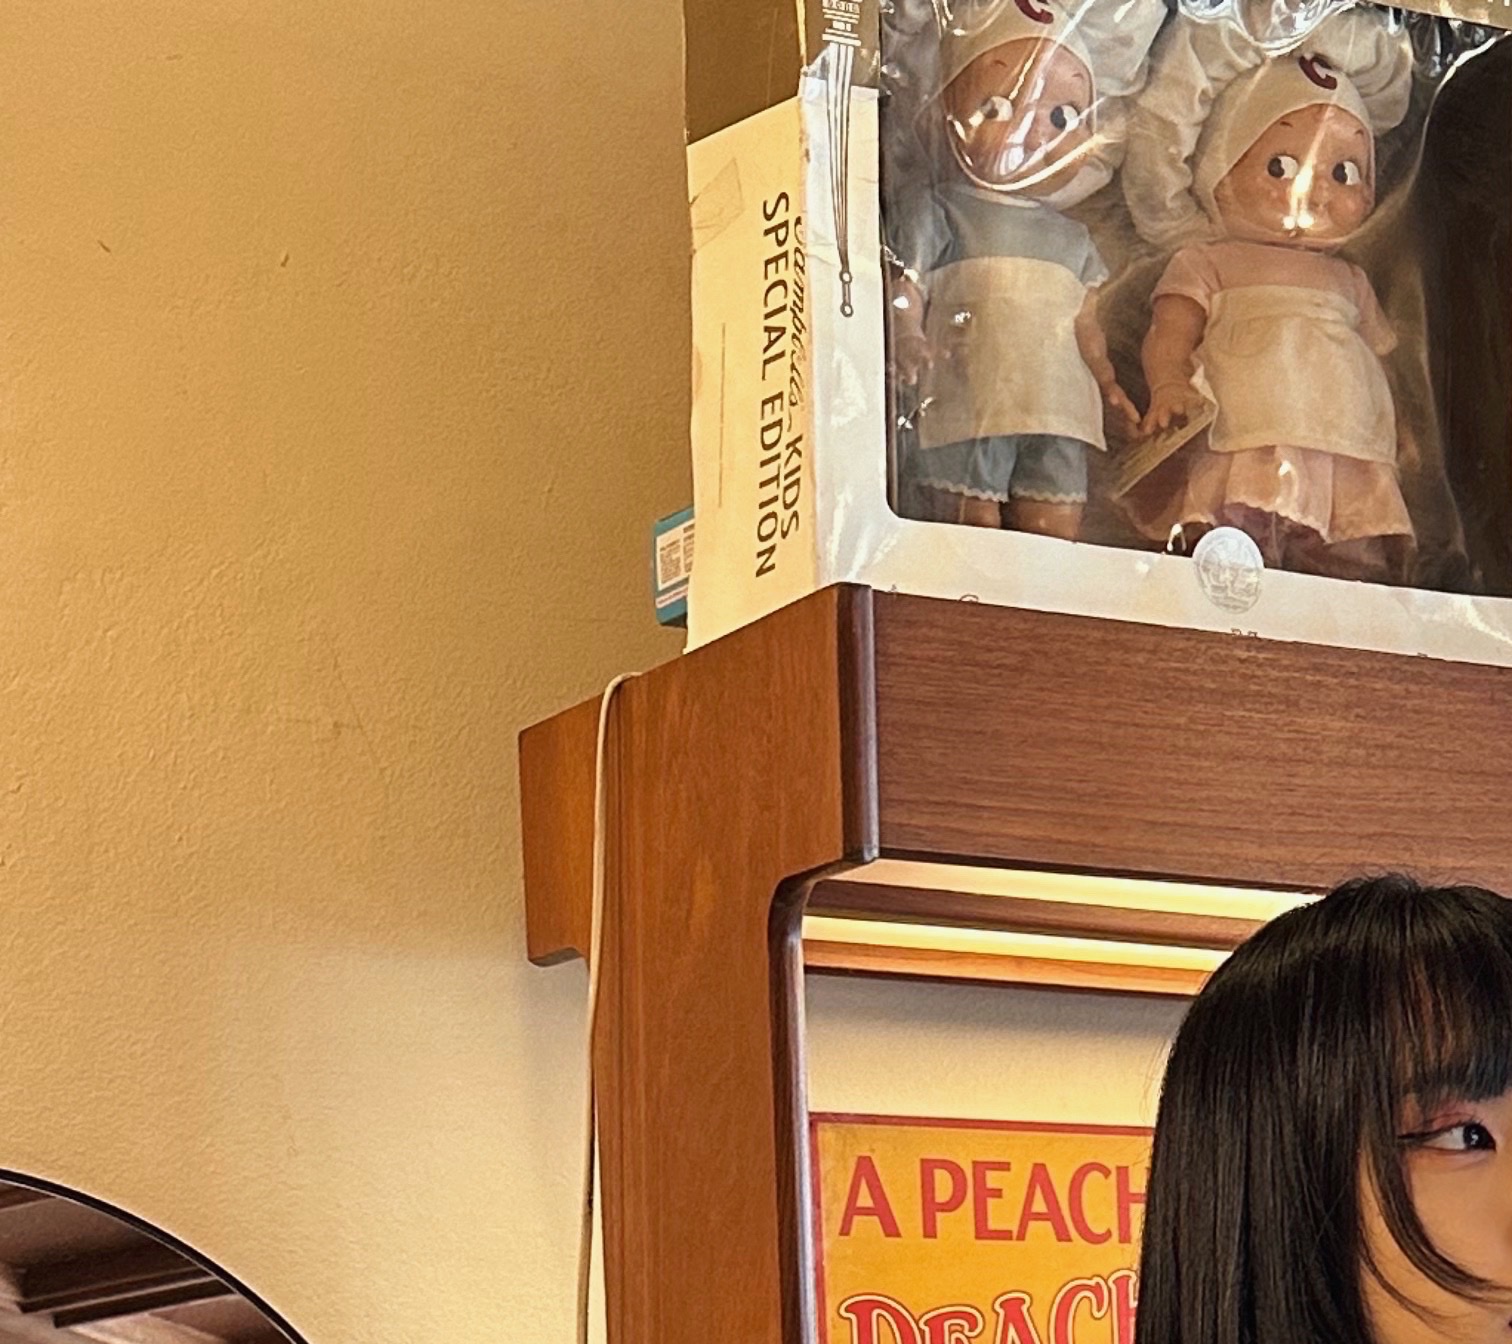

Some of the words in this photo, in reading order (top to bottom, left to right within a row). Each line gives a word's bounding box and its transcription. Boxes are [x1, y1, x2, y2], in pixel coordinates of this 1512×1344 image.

[762, 191, 790, 382] SPECIAL
[755, 390, 786, 579] EDITION
[781, 434, 804, 541] KIDS
[838, 1154, 903, 1239] A
